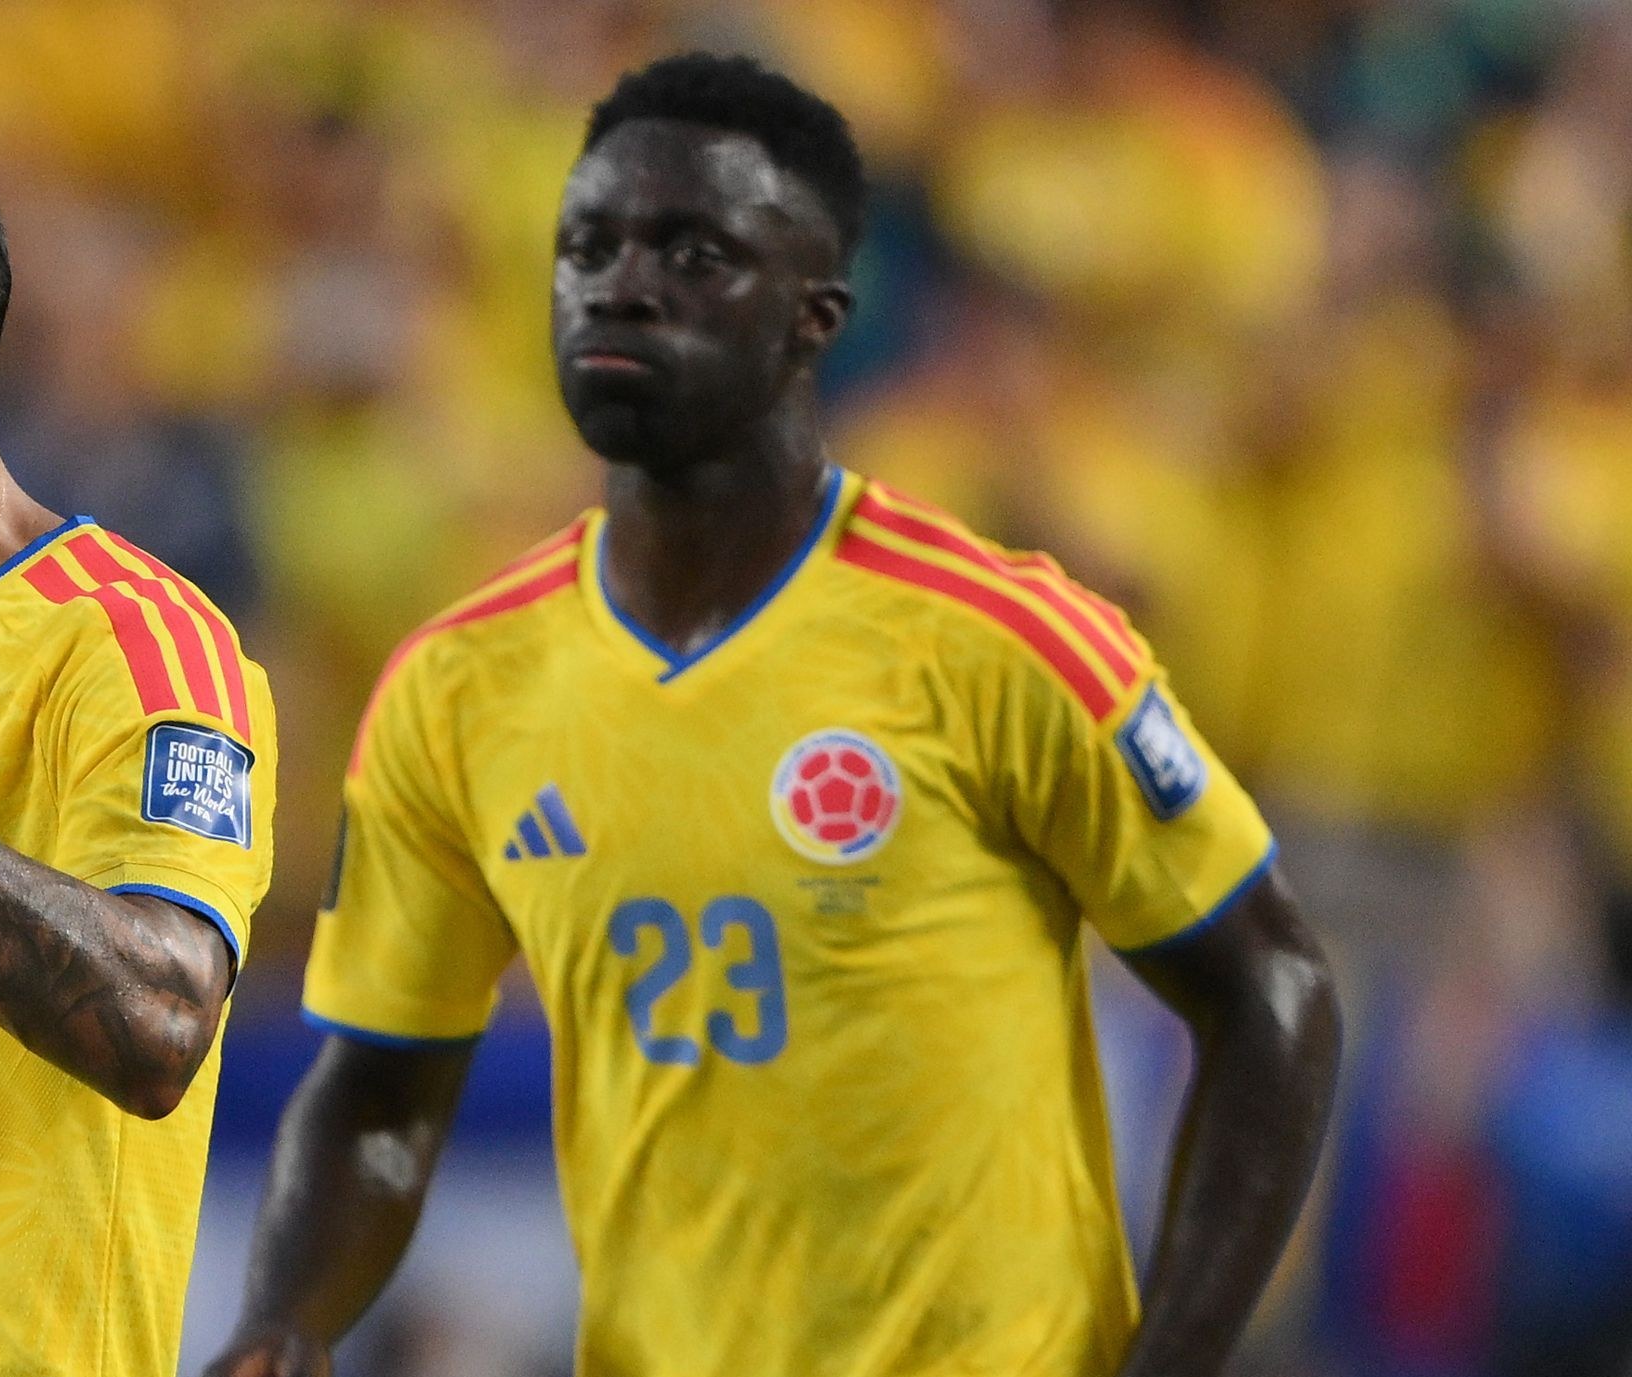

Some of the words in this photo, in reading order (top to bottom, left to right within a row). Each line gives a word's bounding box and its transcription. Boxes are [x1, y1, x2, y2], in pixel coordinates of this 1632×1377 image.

[169, 741, 234, 778] FOOTBALL
[167, 759, 233, 799] UNITES
[160, 782, 191, 796] the
[193, 783, 235, 818] World
[184, 801, 212, 822] FIFA
[608, 895, 788, 1066] 23
